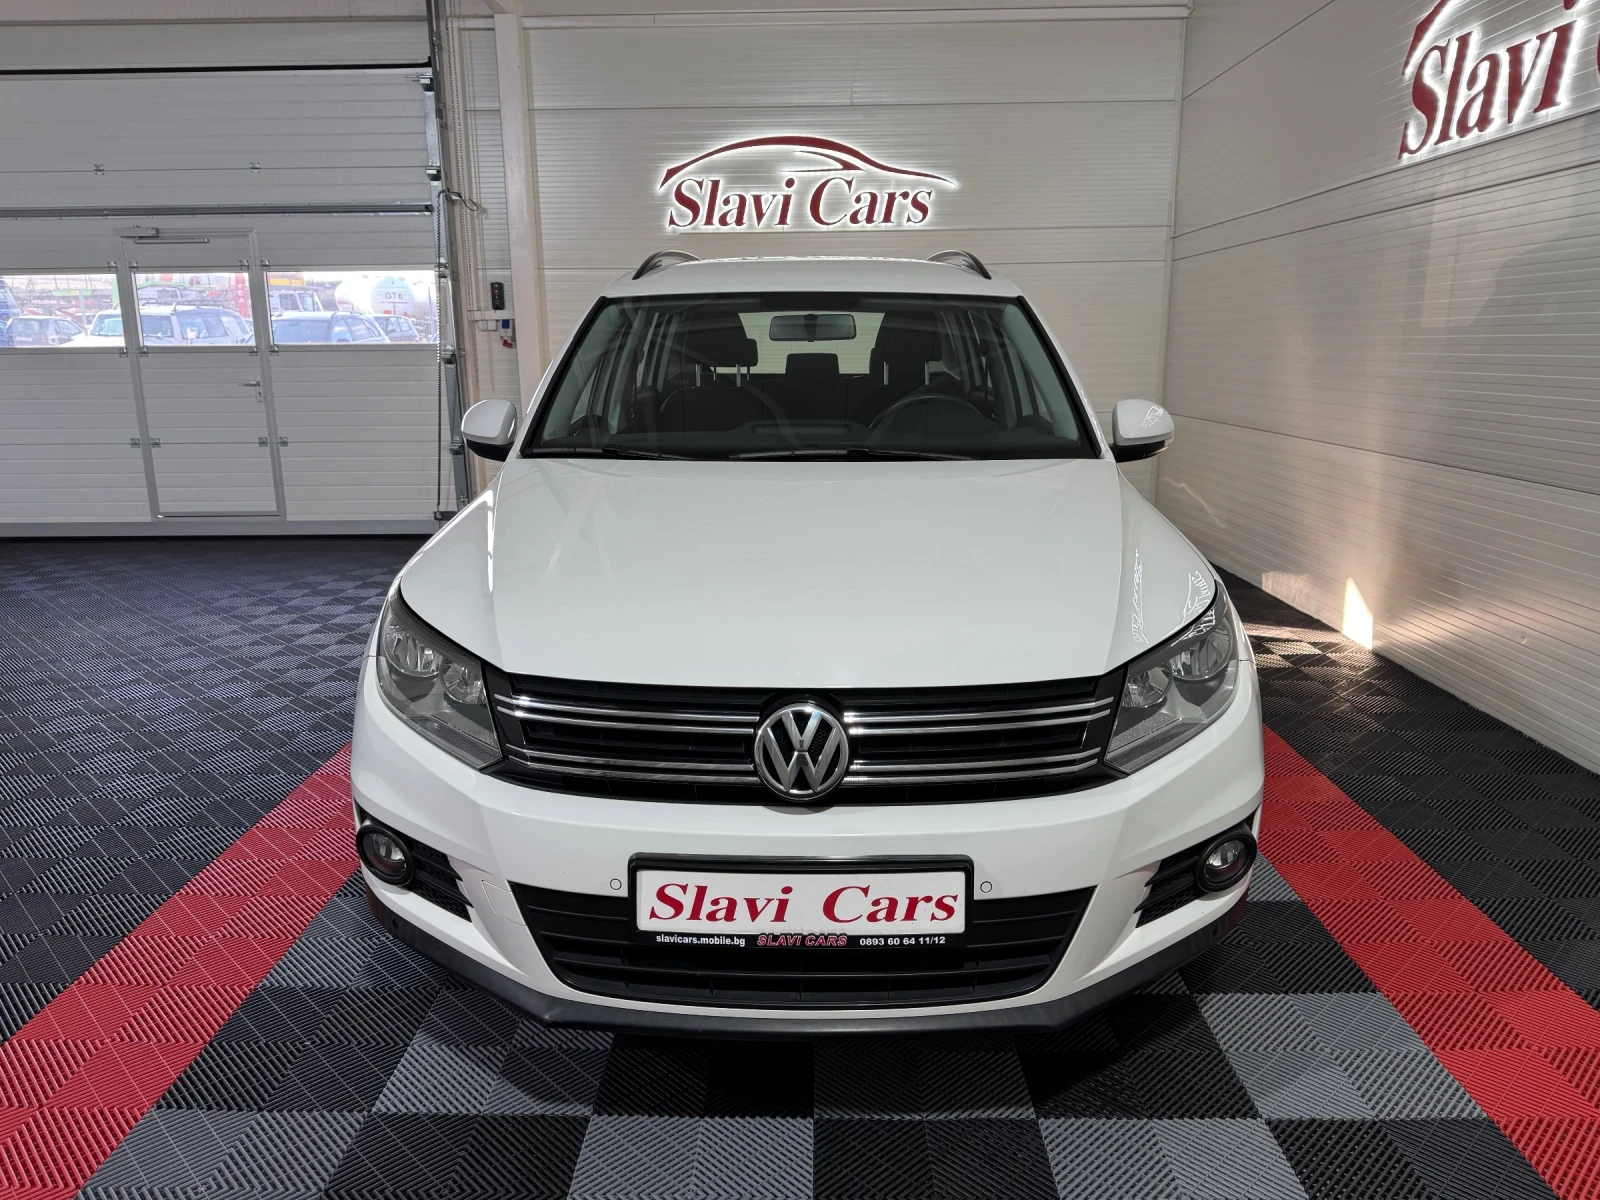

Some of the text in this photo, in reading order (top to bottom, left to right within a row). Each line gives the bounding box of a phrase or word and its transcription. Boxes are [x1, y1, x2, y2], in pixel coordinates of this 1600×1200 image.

[1398, 0, 1577, 160] Slavi
[668, 177, 933, 227] Slavi Cars
[385, 292, 403, 300] GT6
[649, 883, 959, 924] Slavi Cars
[656, 933, 946, 947] slavicars.mobile.bg SLAVI CARS 0893 60 64 11/12
